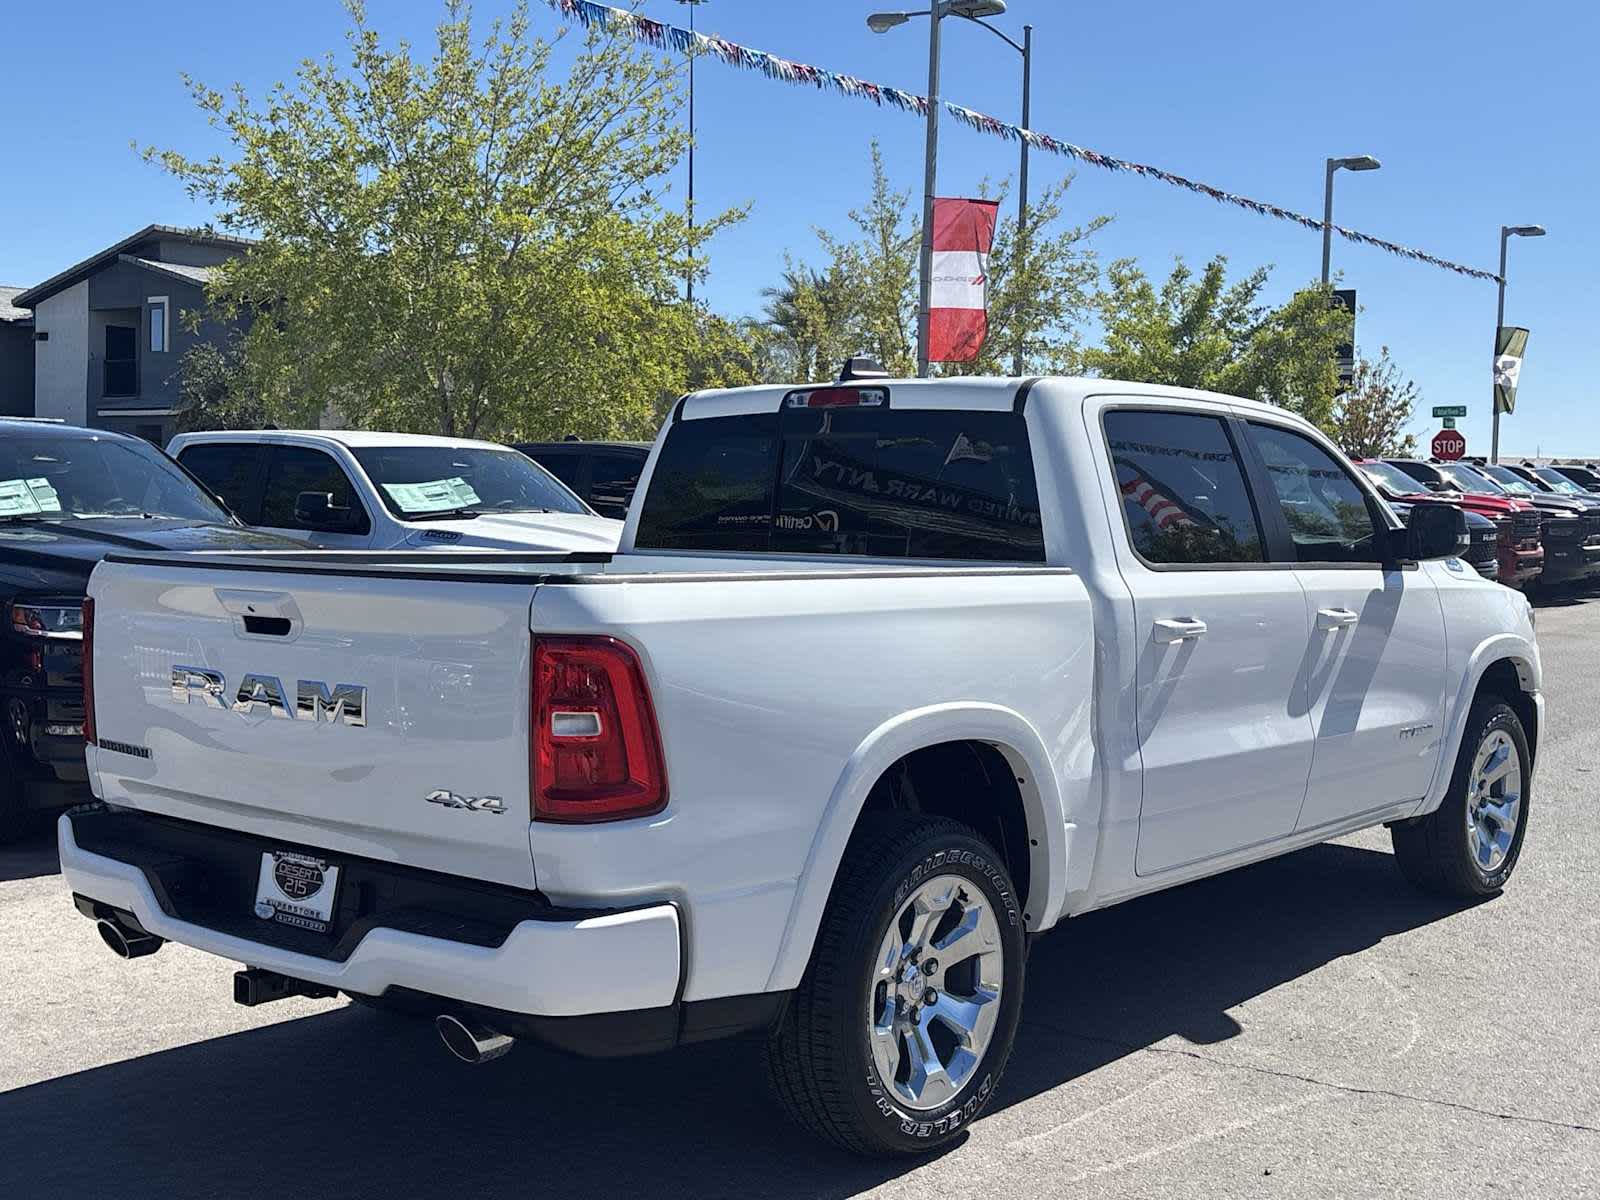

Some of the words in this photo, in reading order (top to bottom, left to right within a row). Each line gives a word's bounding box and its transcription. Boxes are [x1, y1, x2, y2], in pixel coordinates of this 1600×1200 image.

[1433, 439, 1464, 454] STOP
[171, 664, 368, 728] RAM
[279, 863, 321, 881] DESERT
[283, 877, 308, 895] 215
[894, 848, 1019, 927] BRIDGESTONE
